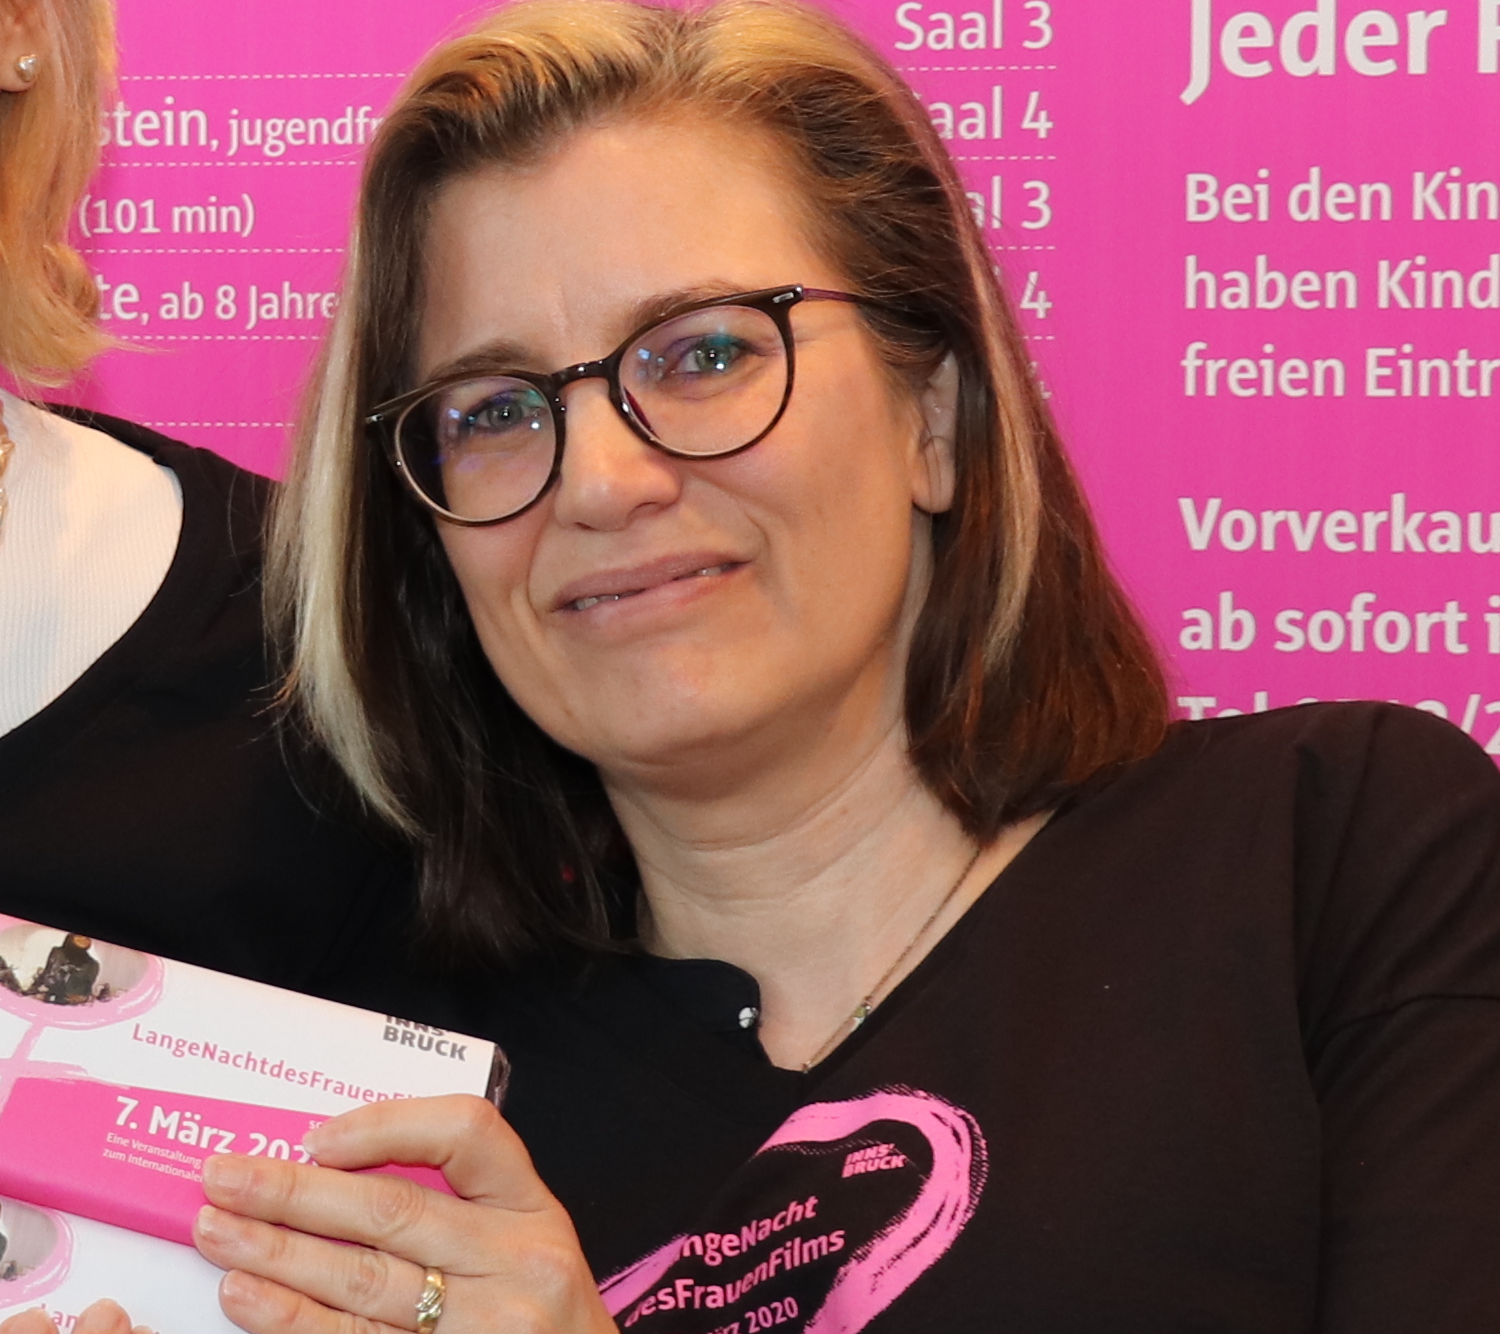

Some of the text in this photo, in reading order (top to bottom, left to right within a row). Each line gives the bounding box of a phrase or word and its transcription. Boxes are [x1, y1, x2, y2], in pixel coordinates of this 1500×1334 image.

[1022, 0, 1054, 50] 3
[911, 85, 1054, 140] aal 4
[78, 193, 255, 238] (101 min)
[1021, 179, 1053, 230] 3
[1185, 168, 1271, 223] Bei
[1287, 166, 1393, 223] den
[159, 280, 204, 320] ab
[215, 284, 237, 320] 8
[1019, 270, 1053, 319] 4
[1184, 254, 1358, 310] haben
[1180, 341, 1345, 398] freien
[1179, 591, 1256, 653] ab
[1274, 592, 1468, 655] sofort
[383, 1024, 468, 1062] BRUCK
[115, 1095, 140, 1130] 7.
[148, 1105, 237, 1155] März
[102, 1148, 204, 1183] zum Internationale
[106, 1132, 203, 1170] Eine Veranstaltung
[841, 1154, 907, 1178] BRUCK
[744, 1296, 799, 1334] 2020
